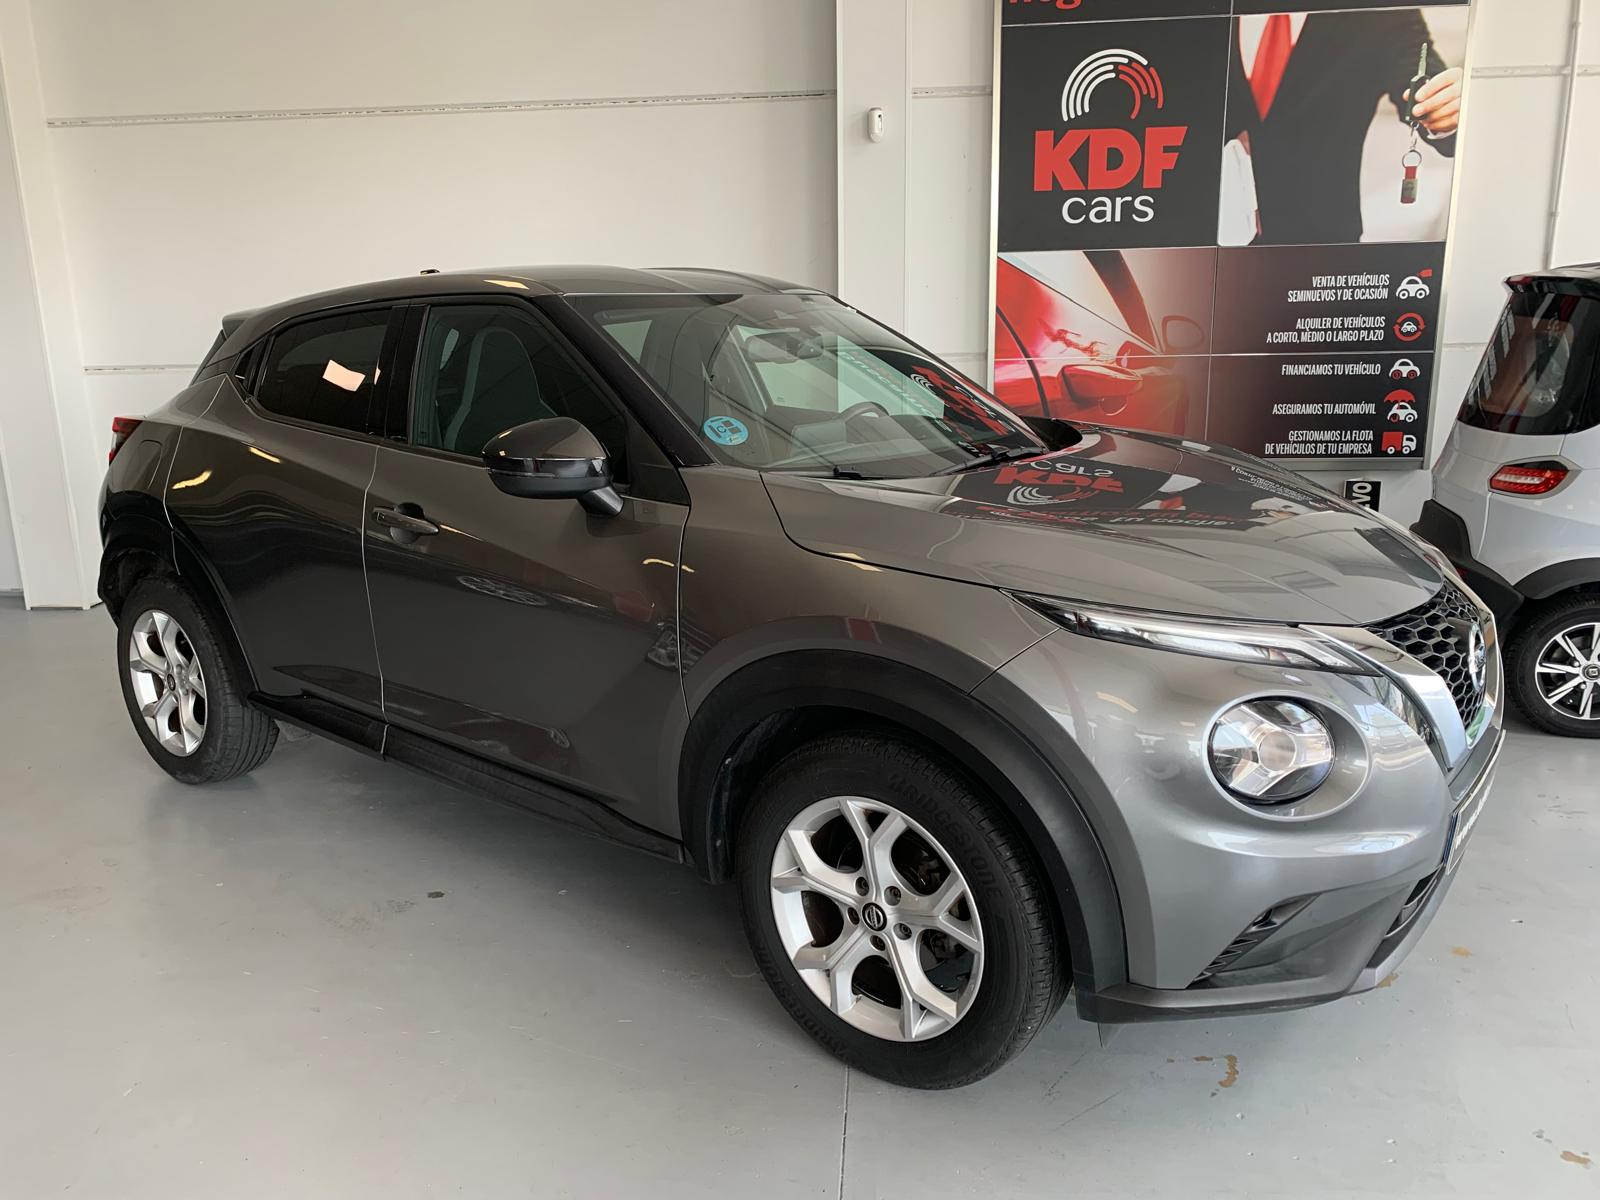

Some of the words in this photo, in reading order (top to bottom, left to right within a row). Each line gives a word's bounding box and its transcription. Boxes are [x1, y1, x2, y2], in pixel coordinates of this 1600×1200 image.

[1033, 126, 1188, 192] KDF
[1061, 195, 1155, 224] cars
[1312, 276, 1336, 288] VENTA
[1336, 275, 1346, 287] DE
[1347, 272, 1390, 286] VEHÍCULOS
[1287, 289, 1336, 303] SEMINUEVOS
[1337, 289, 1343, 300] Y
[1343, 288, 1353, 300] DE
[1354, 285, 1388, 300] OCASIÓN
[1296, 317, 1331, 331] ALQUILER
[1333, 317, 1343, 328] DE
[1343, 314, 1385, 328] VEHÍCULOS
[1266, 332, 1272, 343] A
[1273, 331, 1300, 343] CORTO,
[1300, 331, 1325, 342] MEDIO
[1326, 330, 1333, 342] O
[1333, 330, 1358, 342] LARGO
[1359, 329, 1384, 341] PLAZO
[1281, 364, 1333, 376] FINANCIAMOS
[1334, 363, 1344, 375] TU
[1344, 361, 1381, 375] VEHÍCULO
[1272, 403, 1324, 415] ASEGURAMOS
[1323, 403, 1333, 414] TU
[1333, 400, 1376, 414] AUTOMÓVIL
[1288, 430, 1341, 442] GESTIONAMOS
[1341, 430, 1351, 441] LA
[1352, 430, 1374, 441] FLOTA
[1264, 443, 1275, 455] DE
[1275, 441, 1316, 455] VEHÍCULOS
[1316, 443, 1327, 454] DE
[1327, 443, 1338, 454] TU
[1338, 443, 1373, 454] EMPRESA
